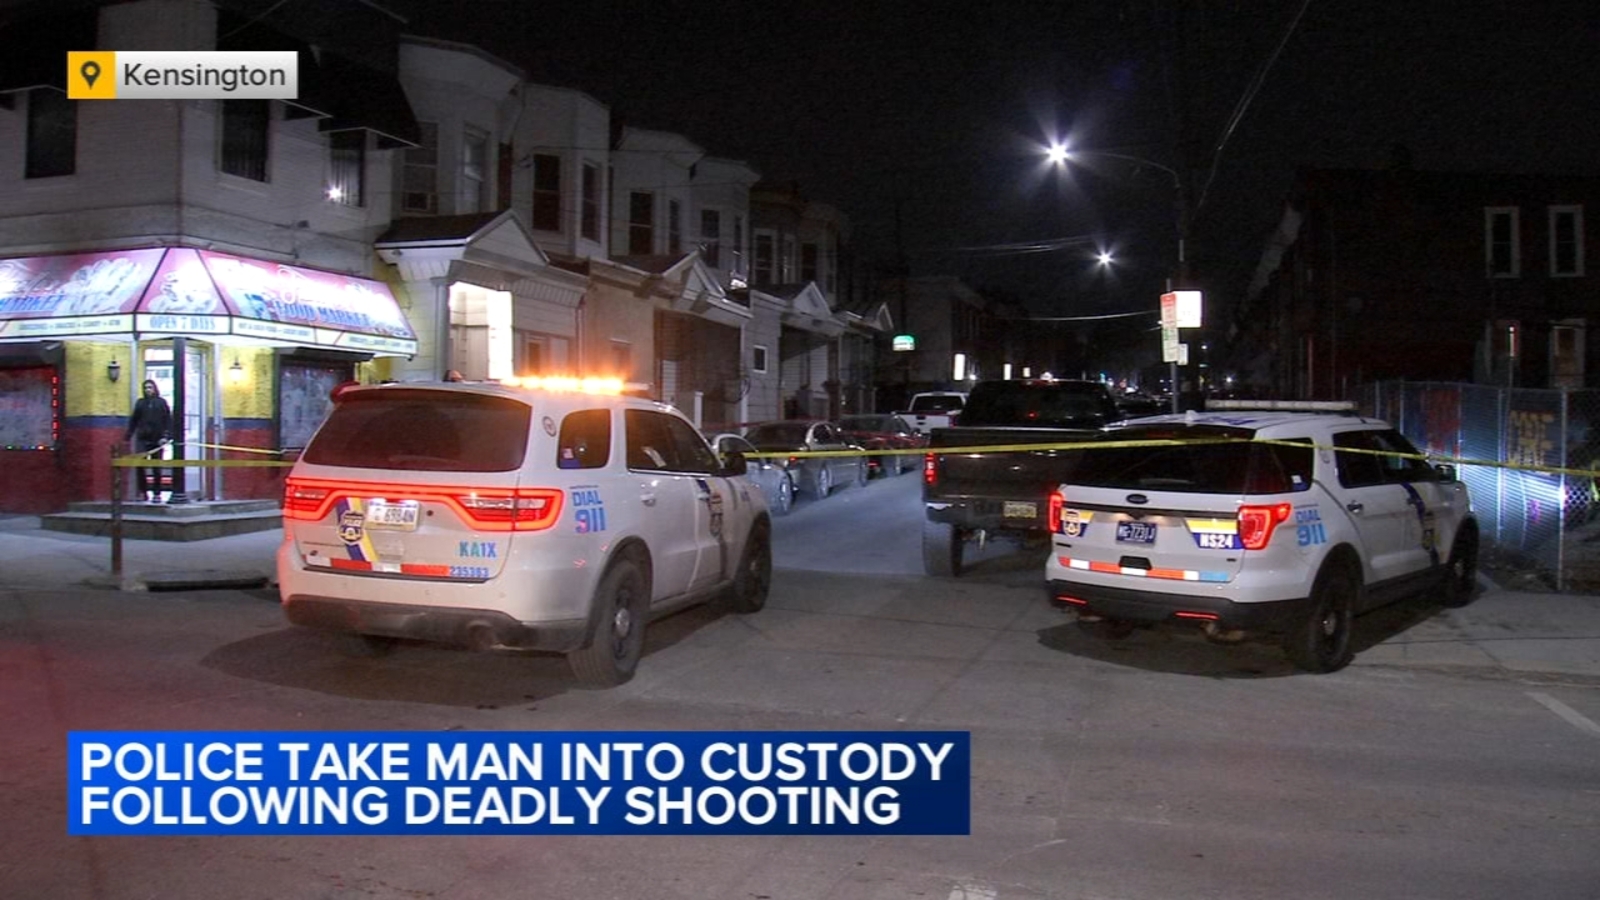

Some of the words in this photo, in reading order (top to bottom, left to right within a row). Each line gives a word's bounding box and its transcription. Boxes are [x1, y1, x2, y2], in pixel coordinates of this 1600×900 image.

[149, 315, 177, 330] OPEN
[181, 316, 188, 330] 7
[190, 316, 216, 331] DAYS
[572, 490, 603, 507] DIAL
[574, 508, 607, 533] 911
[1296, 523, 1327, 547] 911
[459, 541, 498, 558] KA1X
